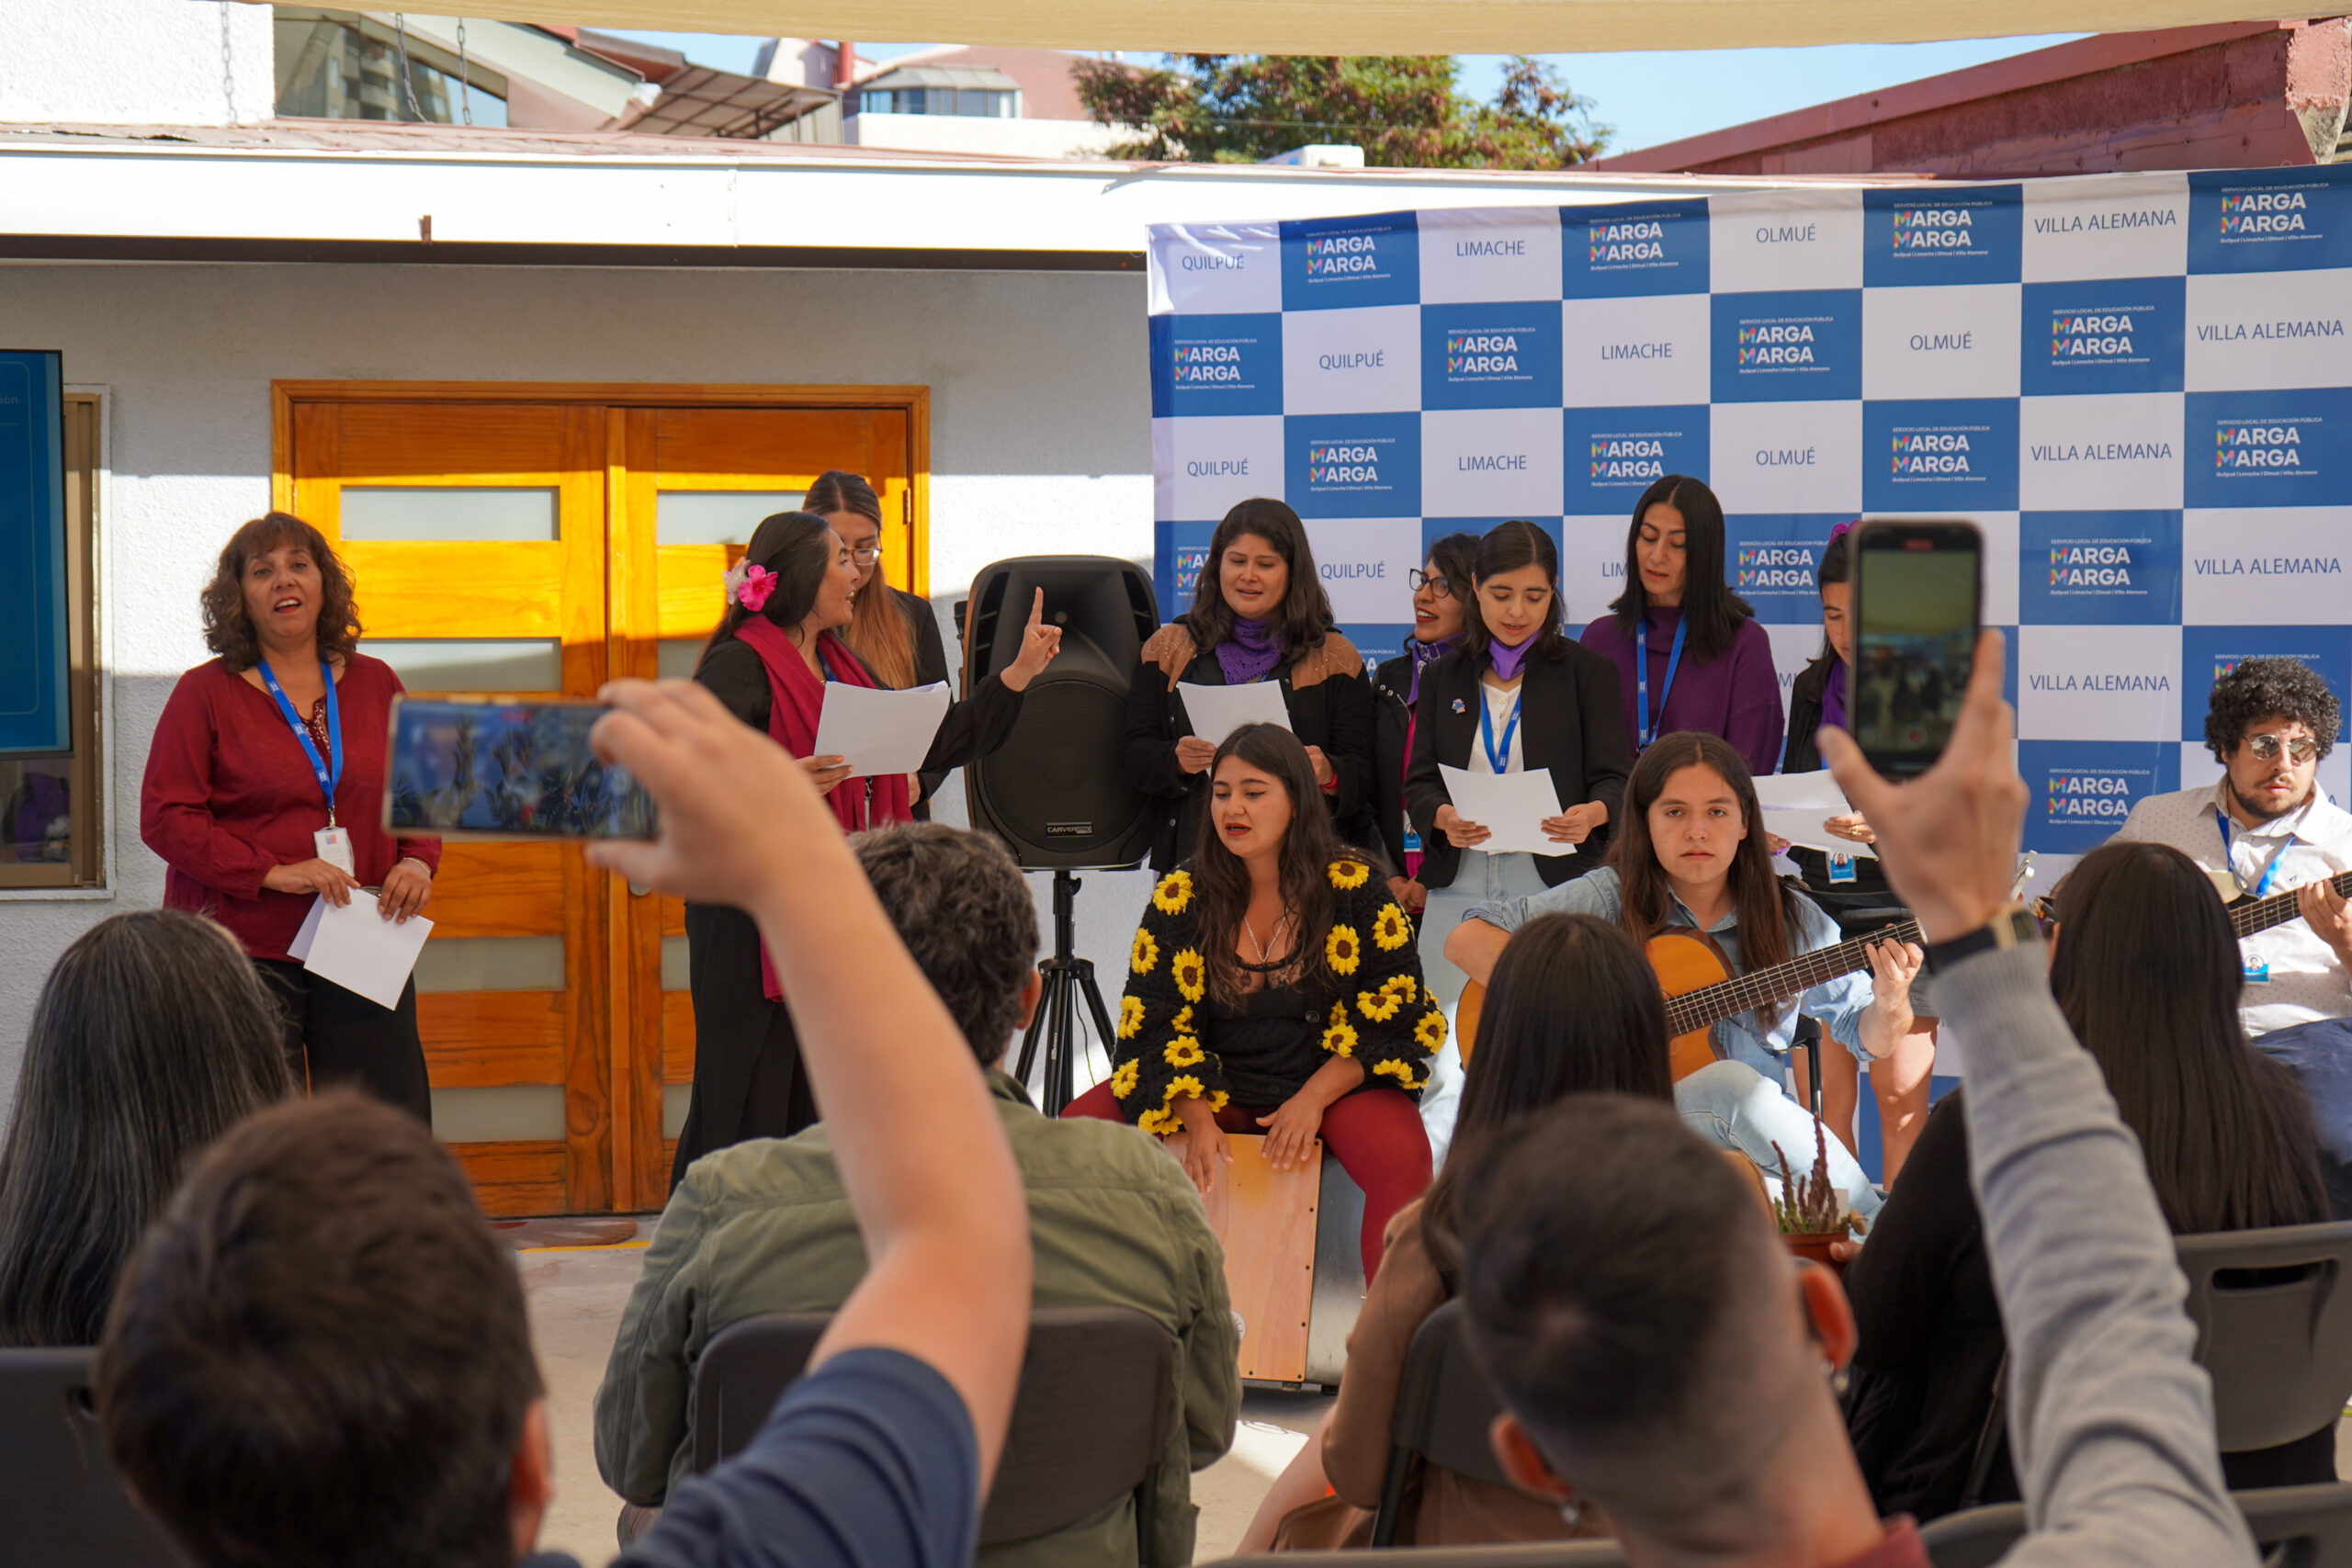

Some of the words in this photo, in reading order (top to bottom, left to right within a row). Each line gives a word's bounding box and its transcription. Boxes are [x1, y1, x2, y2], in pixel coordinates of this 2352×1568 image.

[2222, 193, 2306, 212] MARGA
[1894, 209, 1972, 228] MARGA
[2034, 216, 2083, 233] VILLA
[2087, 209, 2177, 231] ALEMANA
[2221, 214, 2305, 233] MARGA
[1590, 221, 1663, 243] MARGA
[1756, 225, 1816, 243] OLMUÉ
[1894, 231, 1972, 248] MARGA
[1307, 235, 1375, 255] MARGA
[1456, 241, 1524, 256] LIMACHE
[1590, 243, 1663, 262] MARGA
[1182, 254, 1244, 272] QUILPUÉ
[1307, 255, 1376, 275] MARGA
[2052, 315, 2133, 335] MARGA
[2197, 323, 2246, 341] VILLA
[2252, 320, 2344, 339] ALEMANA
[1739, 325, 1814, 344] MARGA
[1910, 331, 1973, 350] OLMUÉ
[1174, 346, 1240, 362] MARGA
[1448, 336, 1518, 354] MARGA
[1601, 343, 1673, 360] LIMACHE
[2052, 336, 2133, 355] MARGA
[1319, 350, 1385, 370] QUILPUÉ
[1448, 355, 1518, 372] MARGA
[1739, 346, 1814, 365] MARGA
[1174, 366, 1240, 381] MARGA
[1893, 434, 1970, 452] MARGA
[2217, 427, 2301, 446] MARGA
[1310, 446, 1378, 463] MARGA
[1591, 441, 1664, 457] MARGA
[1756, 446, 1815, 466] OLMUÉ
[2031, 445, 2079, 461] VILLA
[2084, 443, 2172, 460] ALEMANA
[2216, 449, 2301, 467] MARGA
[1187, 458, 1249, 477] QUILPUÉ
[1459, 455, 1527, 471] LIMACHE
[1591, 460, 1664, 478] MARGA
[1893, 456, 1970, 472] MARGA
[1310, 466, 1378, 482] MARGA
[1739, 549, 1814, 566] MARGA
[2051, 547, 2131, 564] MARGA
[1320, 563, 1385, 580] QUILPUÉ
[2194, 558, 2245, 575] VILLA
[2249, 558, 2341, 574] ALEMANA
[1739, 570, 1814, 586] MARGA
[2051, 569, 2131, 585] MARGA
[2030, 674, 2077, 691] VILLA
[2082, 675, 2170, 691] ALEMANA
[2049, 777, 2129, 795] MARGA
[2049, 798, 2129, 816] MARGA
